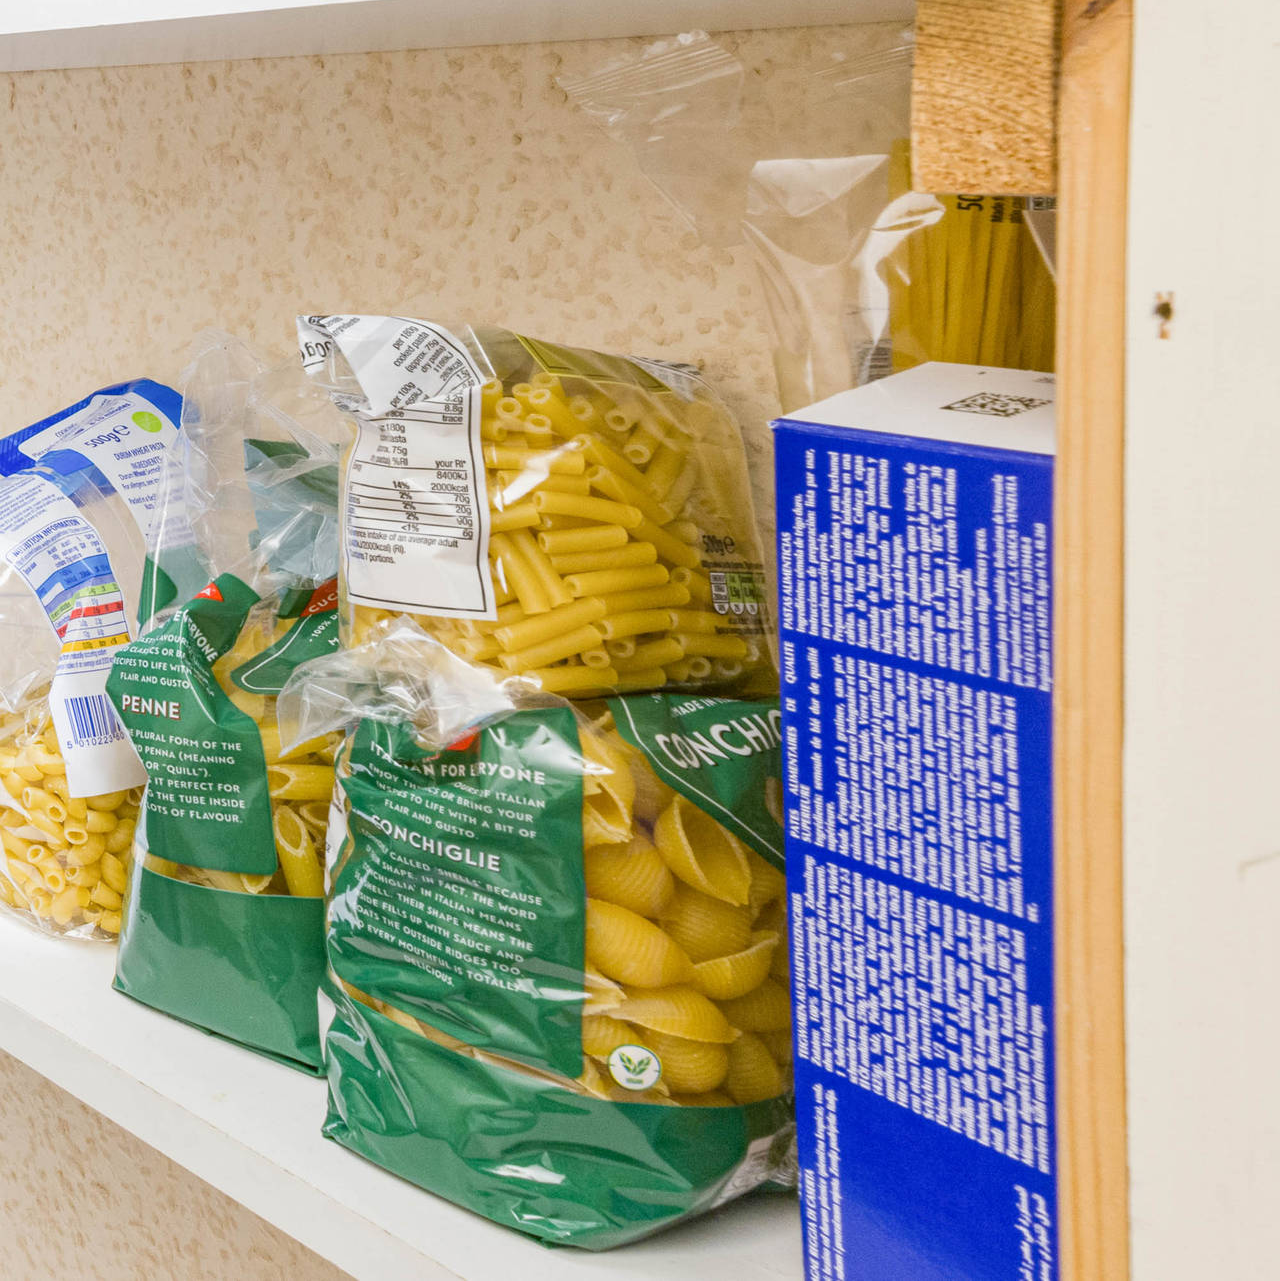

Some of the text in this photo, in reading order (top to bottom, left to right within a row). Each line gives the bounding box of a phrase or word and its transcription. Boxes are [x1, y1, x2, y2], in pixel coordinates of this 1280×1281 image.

[393, 331, 429, 368] cooked pasta
[83, 429, 121, 450] 500g
[434, 459, 453, 469] your
[436, 470, 468, 481] 8400kJ
[430, 482, 469, 493] 2000kcal
[781, 531, 796, 631] PASTAS ALIMENTICIAS
[120, 671, 192, 689] FLAIR AND GUSTO
[122, 694, 182, 721] PENNE
[135, 729, 242, 752] PLURAL FORM OF THE
[783, 641, 801, 840] PATES ALIMENTAIRES QUALITE
[144, 746, 236, 766] PENNA (MEANING
[156, 792, 246, 809] THE TUBE INSIDE
[456, 796, 534, 823] BRING YOUR
[453, 932, 525, 963] SAUCE AND
